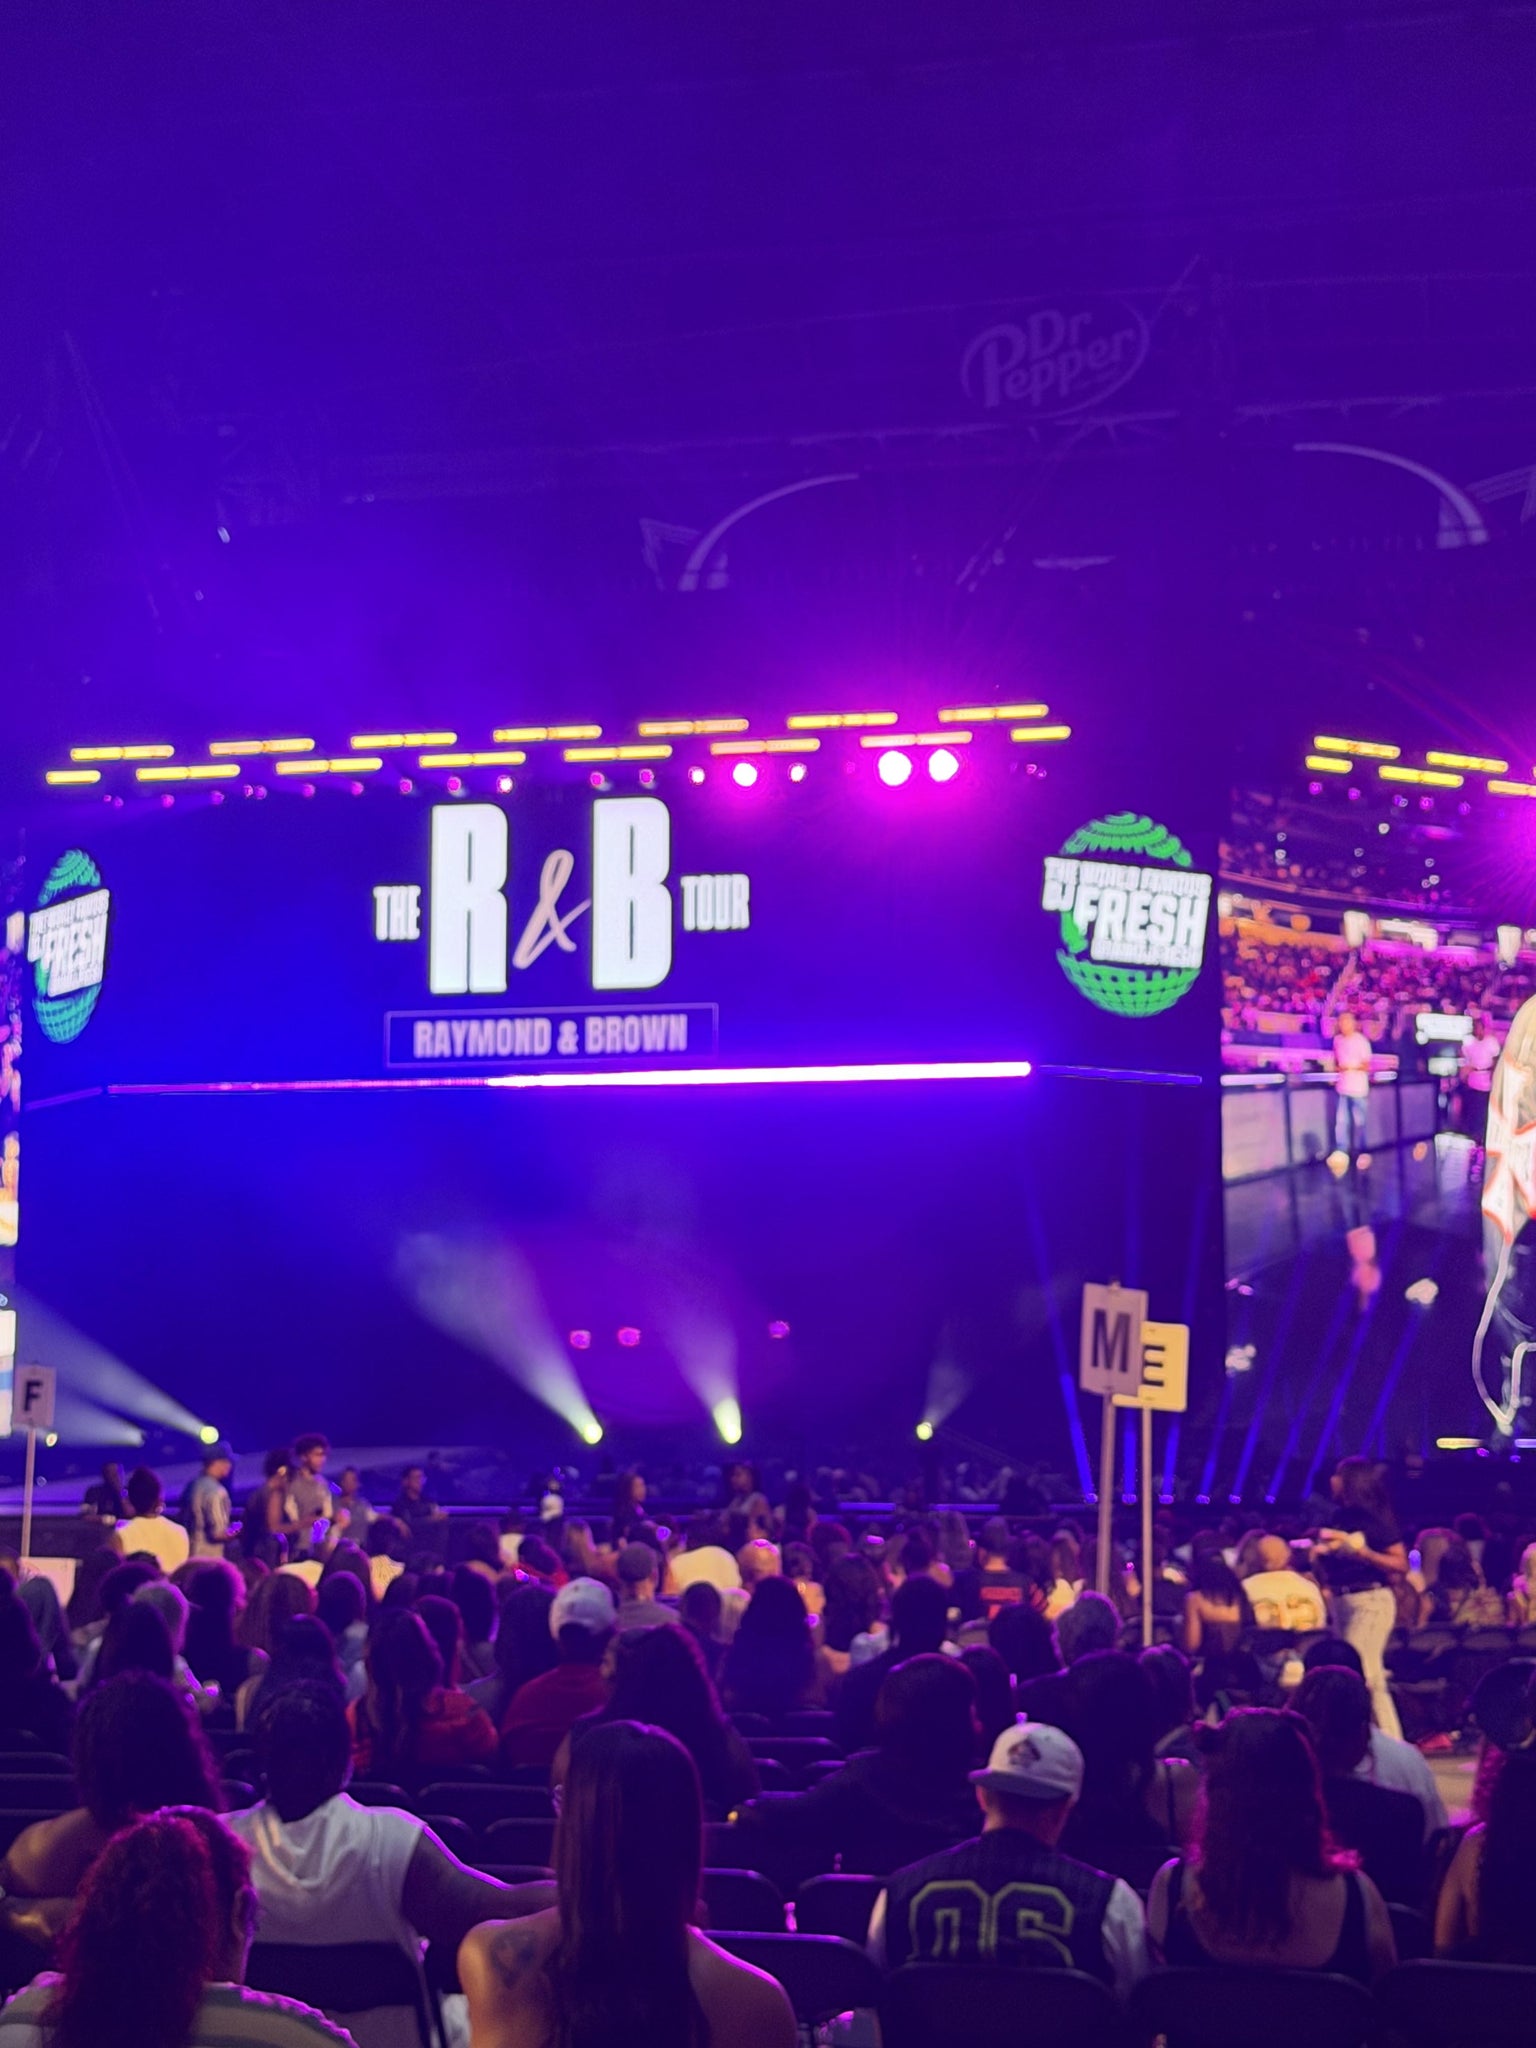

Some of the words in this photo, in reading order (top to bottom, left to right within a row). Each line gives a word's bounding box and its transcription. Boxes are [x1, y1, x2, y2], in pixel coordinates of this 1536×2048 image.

[1028, 309, 1093, 361] Dr
[961, 323, 1136, 408] Pepper
[372, 884, 421, 940] THE
[680, 873, 750, 931] TOUR
[1073, 884, 1209, 947] FRESH
[413, 1018, 552, 1059] RAYMOND
[556, 1020, 579, 1055] &
[585, 1013, 688, 1055] BROWN
[1092, 1308, 1131, 1373] M
[1142, 1344, 1165, 1386] E
[24, 1381, 42, 1411] F
